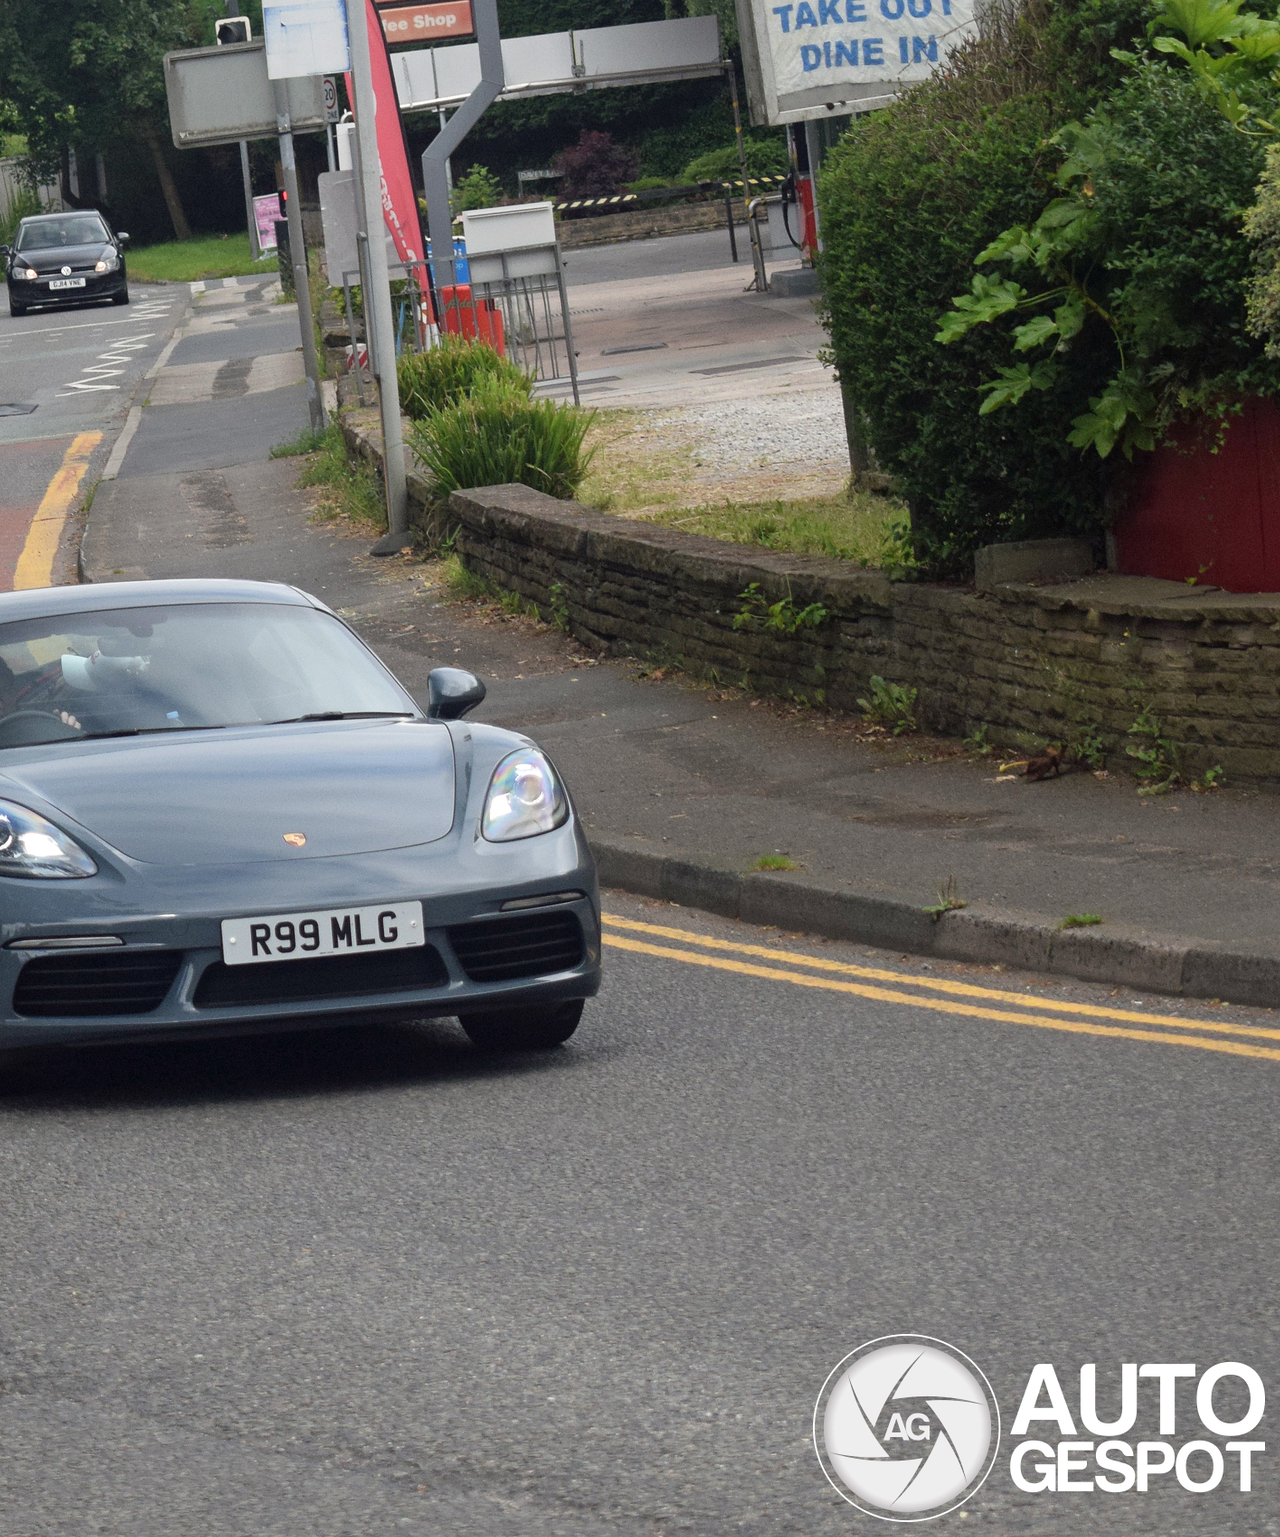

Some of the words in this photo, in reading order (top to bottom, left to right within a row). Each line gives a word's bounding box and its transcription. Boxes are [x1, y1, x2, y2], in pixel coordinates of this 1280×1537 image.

[412, 13, 457, 30] Shop
[772, 0, 868, 33] TAKE
[800, 37, 885, 72] DINE
[898, 34, 938, 64] IN
[324, 88, 334, 101] 20
[250, 918, 321, 956] R99
[330, 910, 399, 949] MLG
